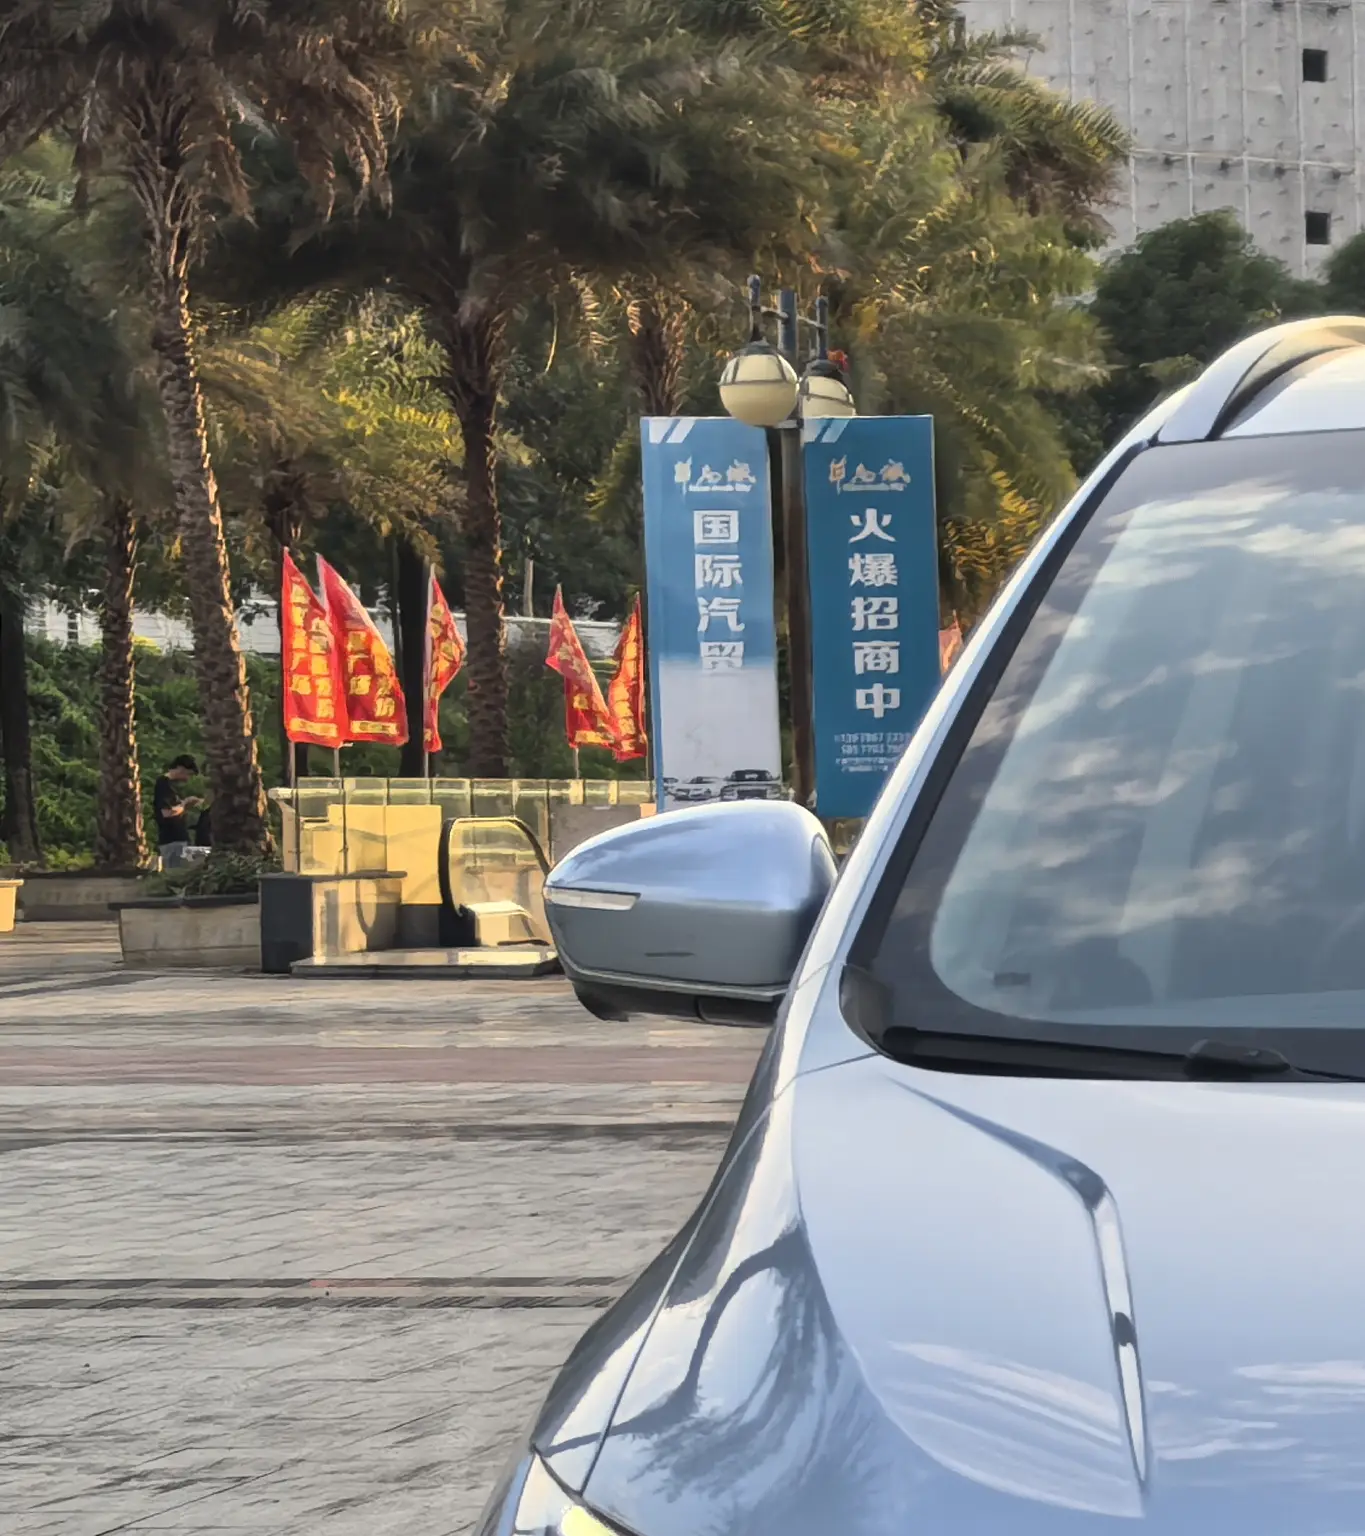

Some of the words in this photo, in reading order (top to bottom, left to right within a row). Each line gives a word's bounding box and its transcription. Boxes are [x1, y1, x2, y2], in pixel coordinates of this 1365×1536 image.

[693, 510, 746, 676] 国际汽贸
[848, 508, 901, 718] 火爆招商中
